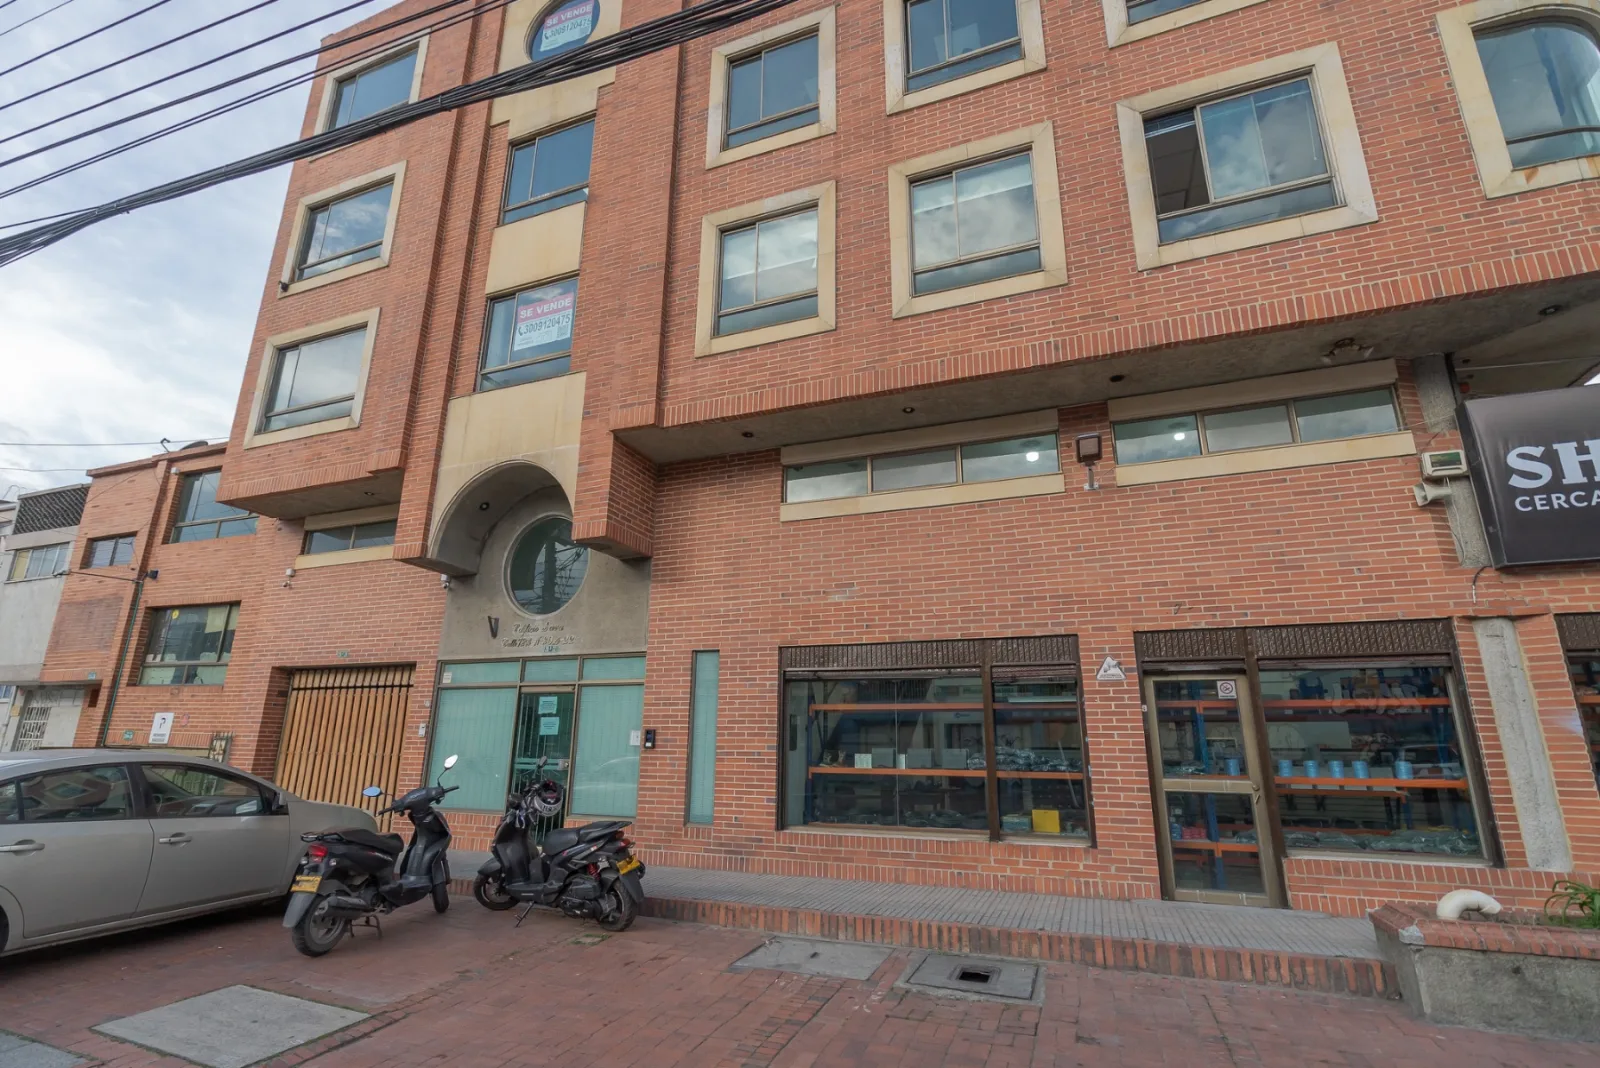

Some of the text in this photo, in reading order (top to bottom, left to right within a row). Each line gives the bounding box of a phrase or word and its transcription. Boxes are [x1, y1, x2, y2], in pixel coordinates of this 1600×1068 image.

[547, 3, 593, 27] SE VENDE
[520, 297, 572, 319] SE VENDE
[523, 313, 571, 334] 3009120475
